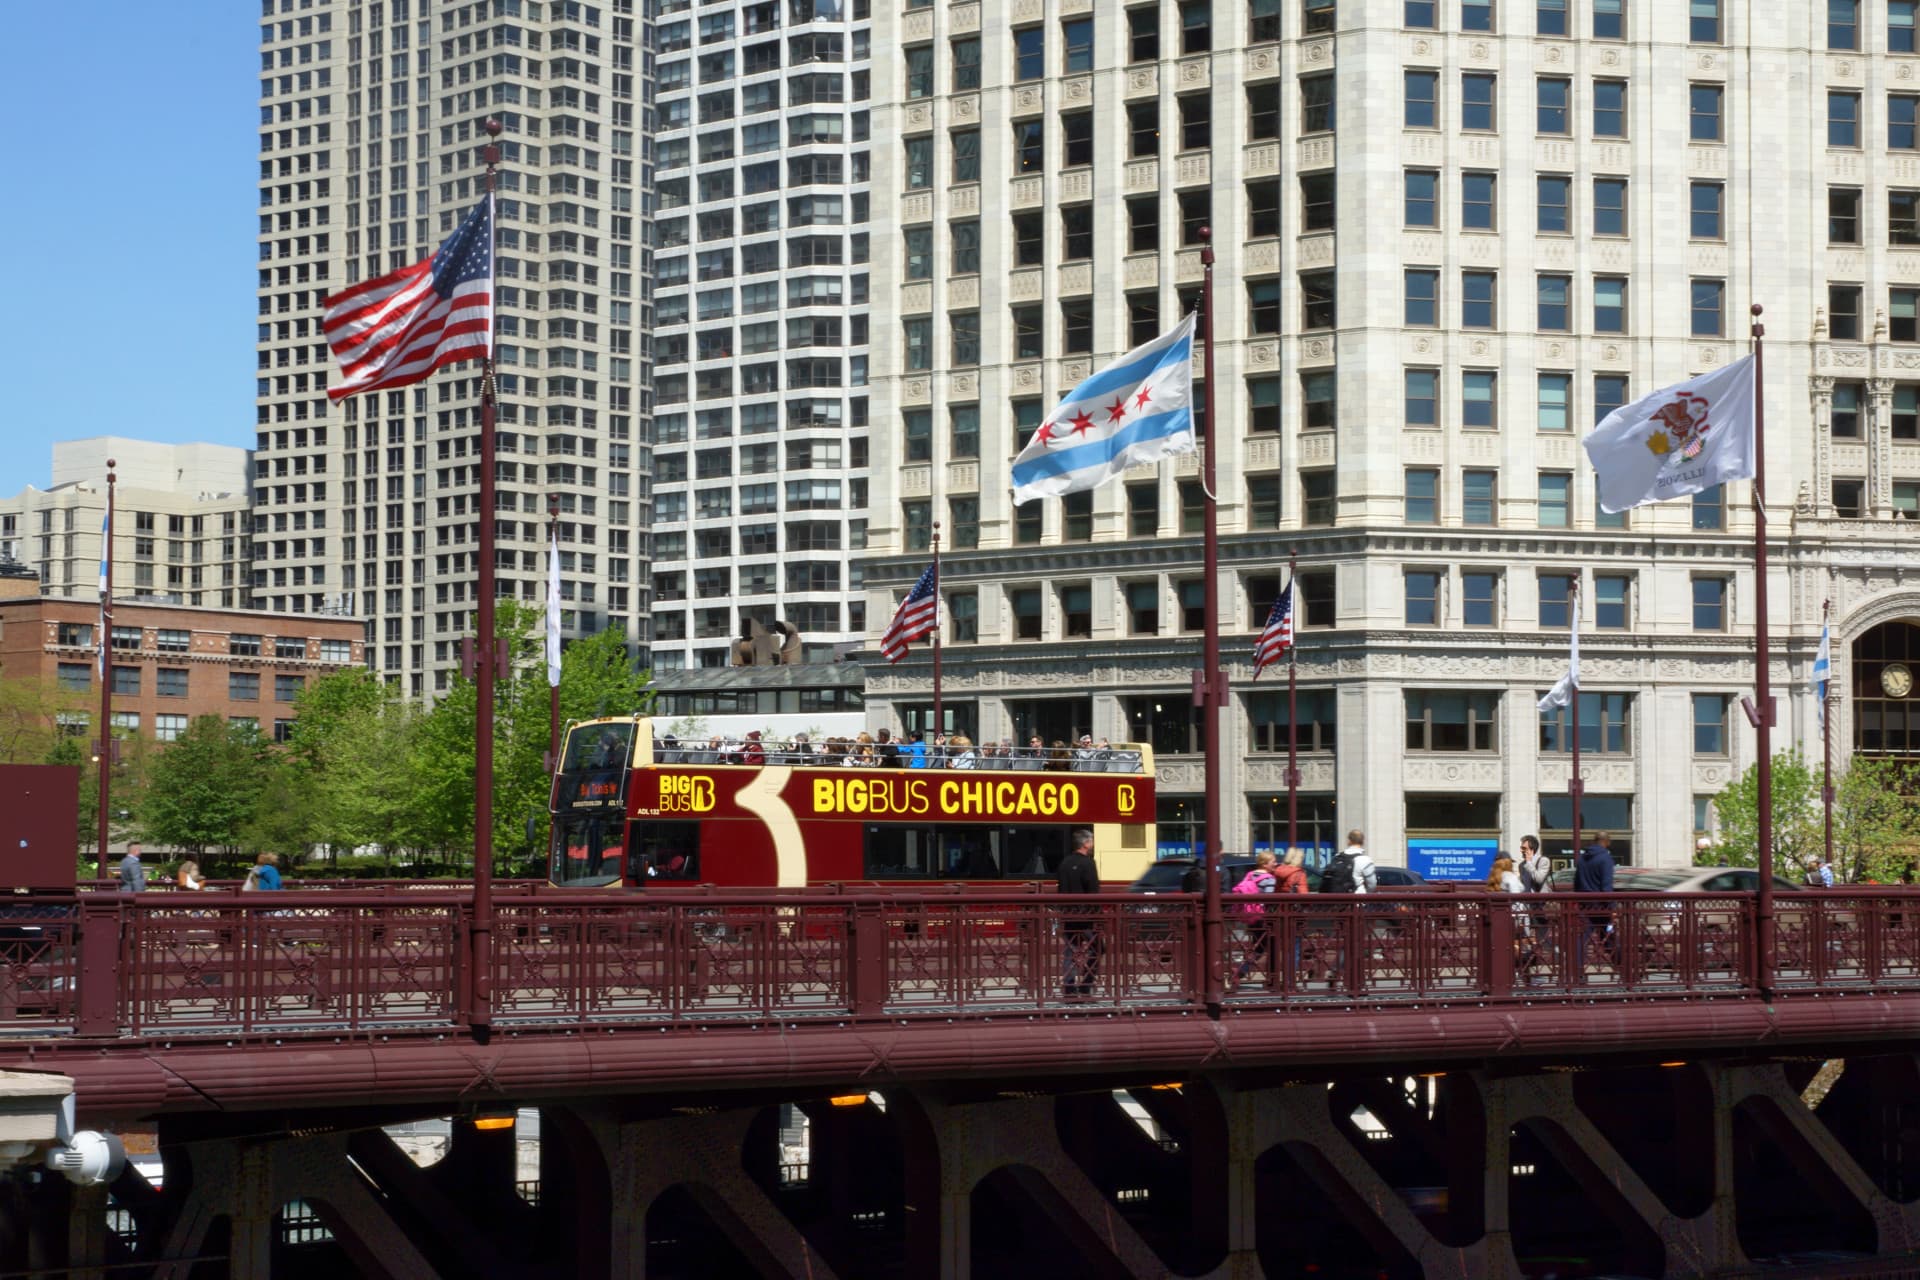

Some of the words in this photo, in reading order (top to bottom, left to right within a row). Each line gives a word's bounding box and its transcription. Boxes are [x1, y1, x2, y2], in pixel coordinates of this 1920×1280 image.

[659, 775, 691, 794] BIG
[659, 794, 691, 812] BUS
[940, 780, 1079, 815] CHICAGO
